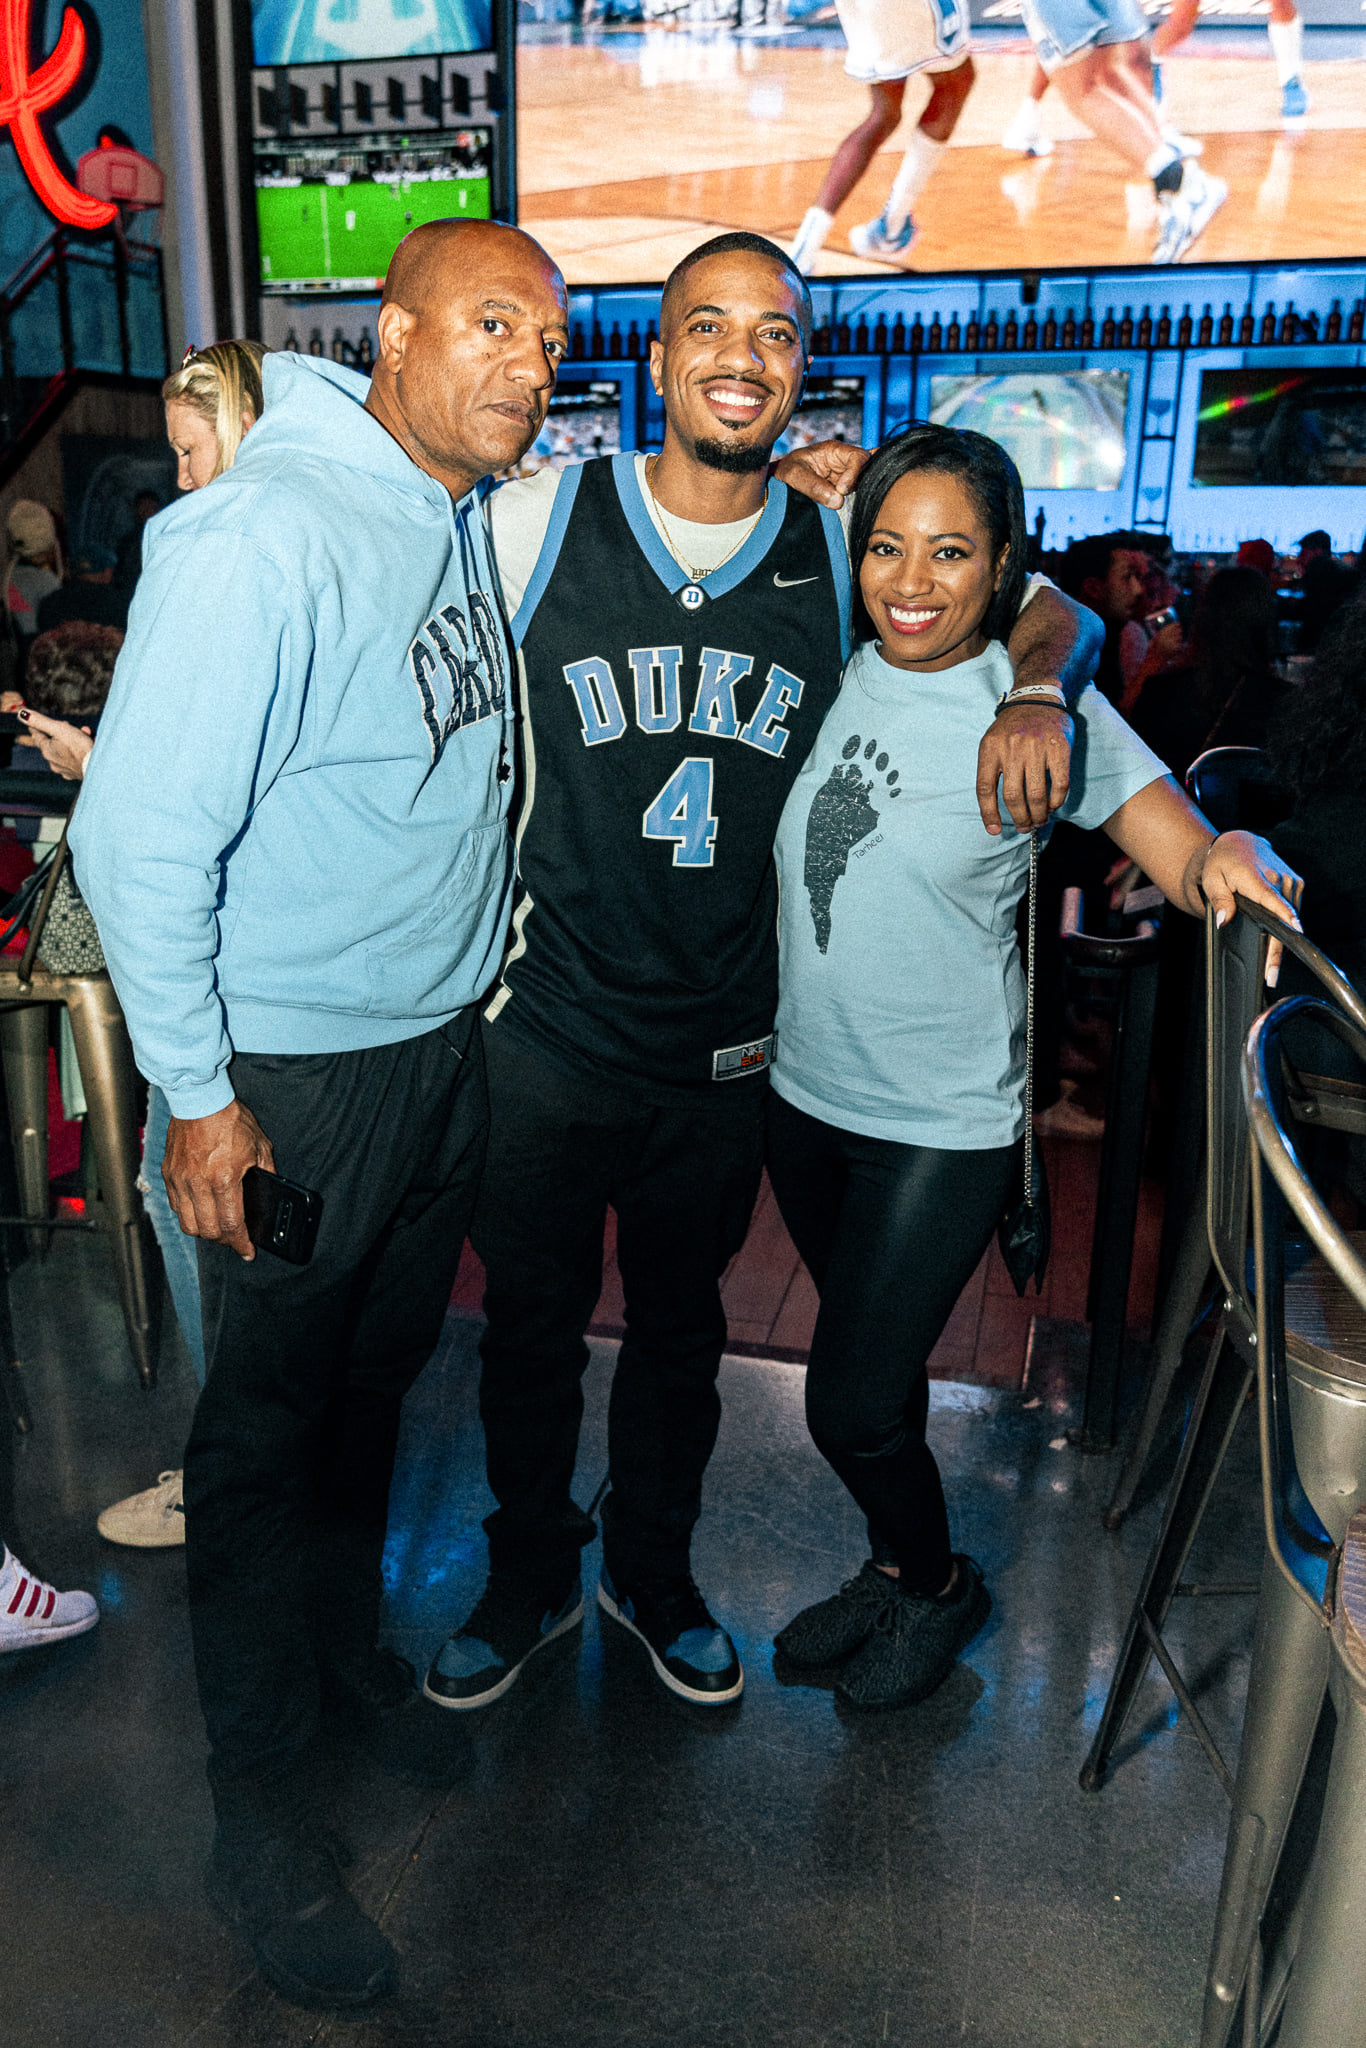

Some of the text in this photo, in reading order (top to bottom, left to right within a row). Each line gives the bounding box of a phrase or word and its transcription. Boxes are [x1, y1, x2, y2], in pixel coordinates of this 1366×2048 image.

[686, 591, 699, 603] D
[562, 645, 806, 758] DUKE
[642, 757, 719, 868] 4
[852, 833, 884, 859] Tarheel
[741, 1043, 765, 1057] NIKE
[741, 1052, 764, 1066] ELITE
